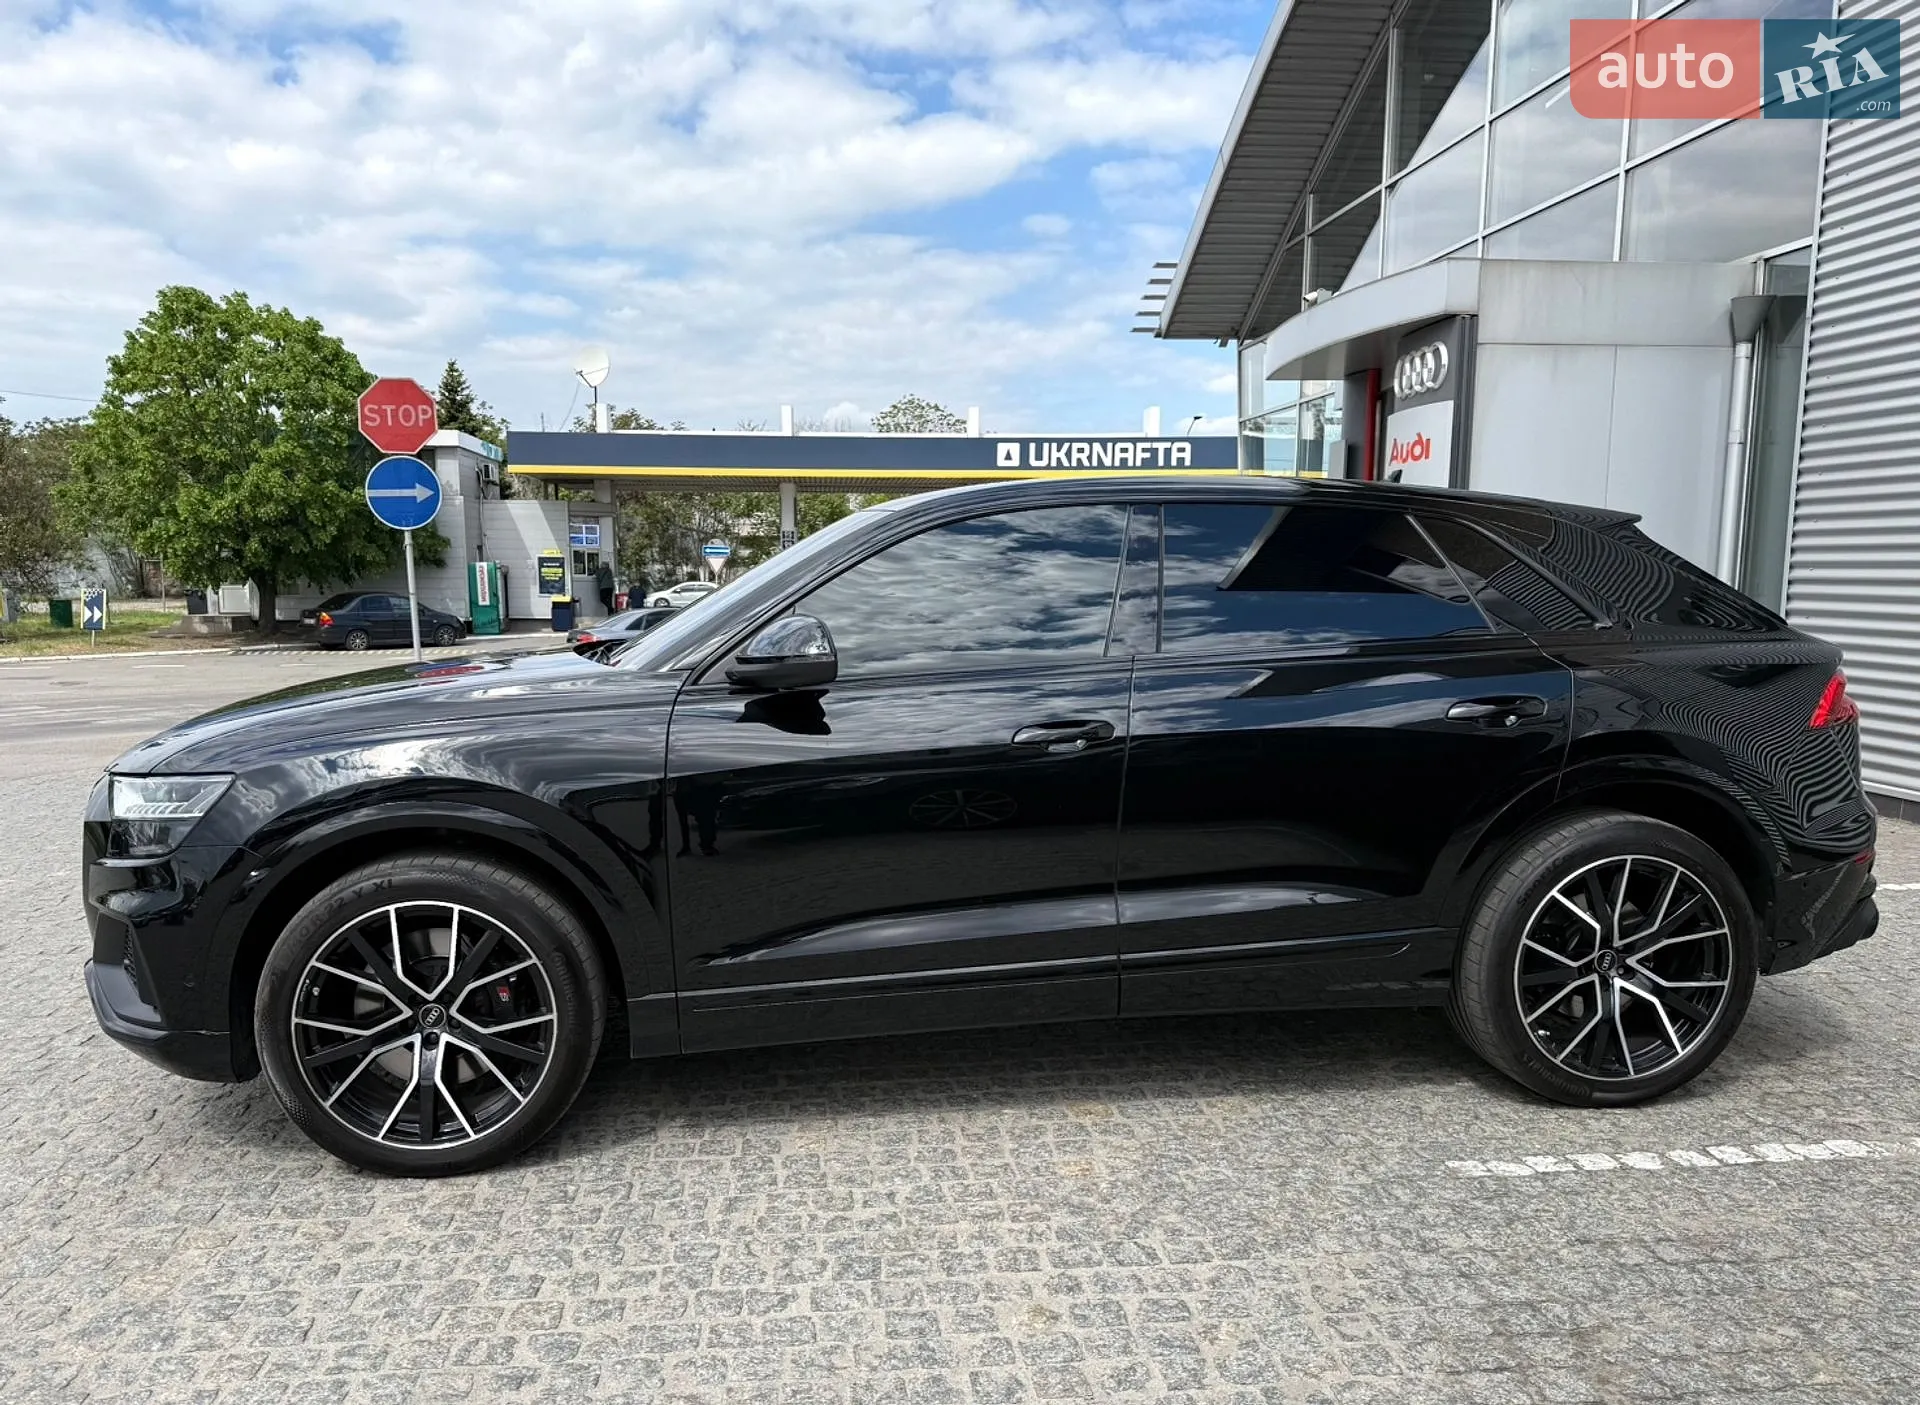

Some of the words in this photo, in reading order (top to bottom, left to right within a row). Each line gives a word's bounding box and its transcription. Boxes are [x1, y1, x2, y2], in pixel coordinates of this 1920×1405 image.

[364, 404, 432, 427] STOP
[1028, 442, 1192, 467] UKRNAFTA
[1388, 432, 1431, 467] Audi
